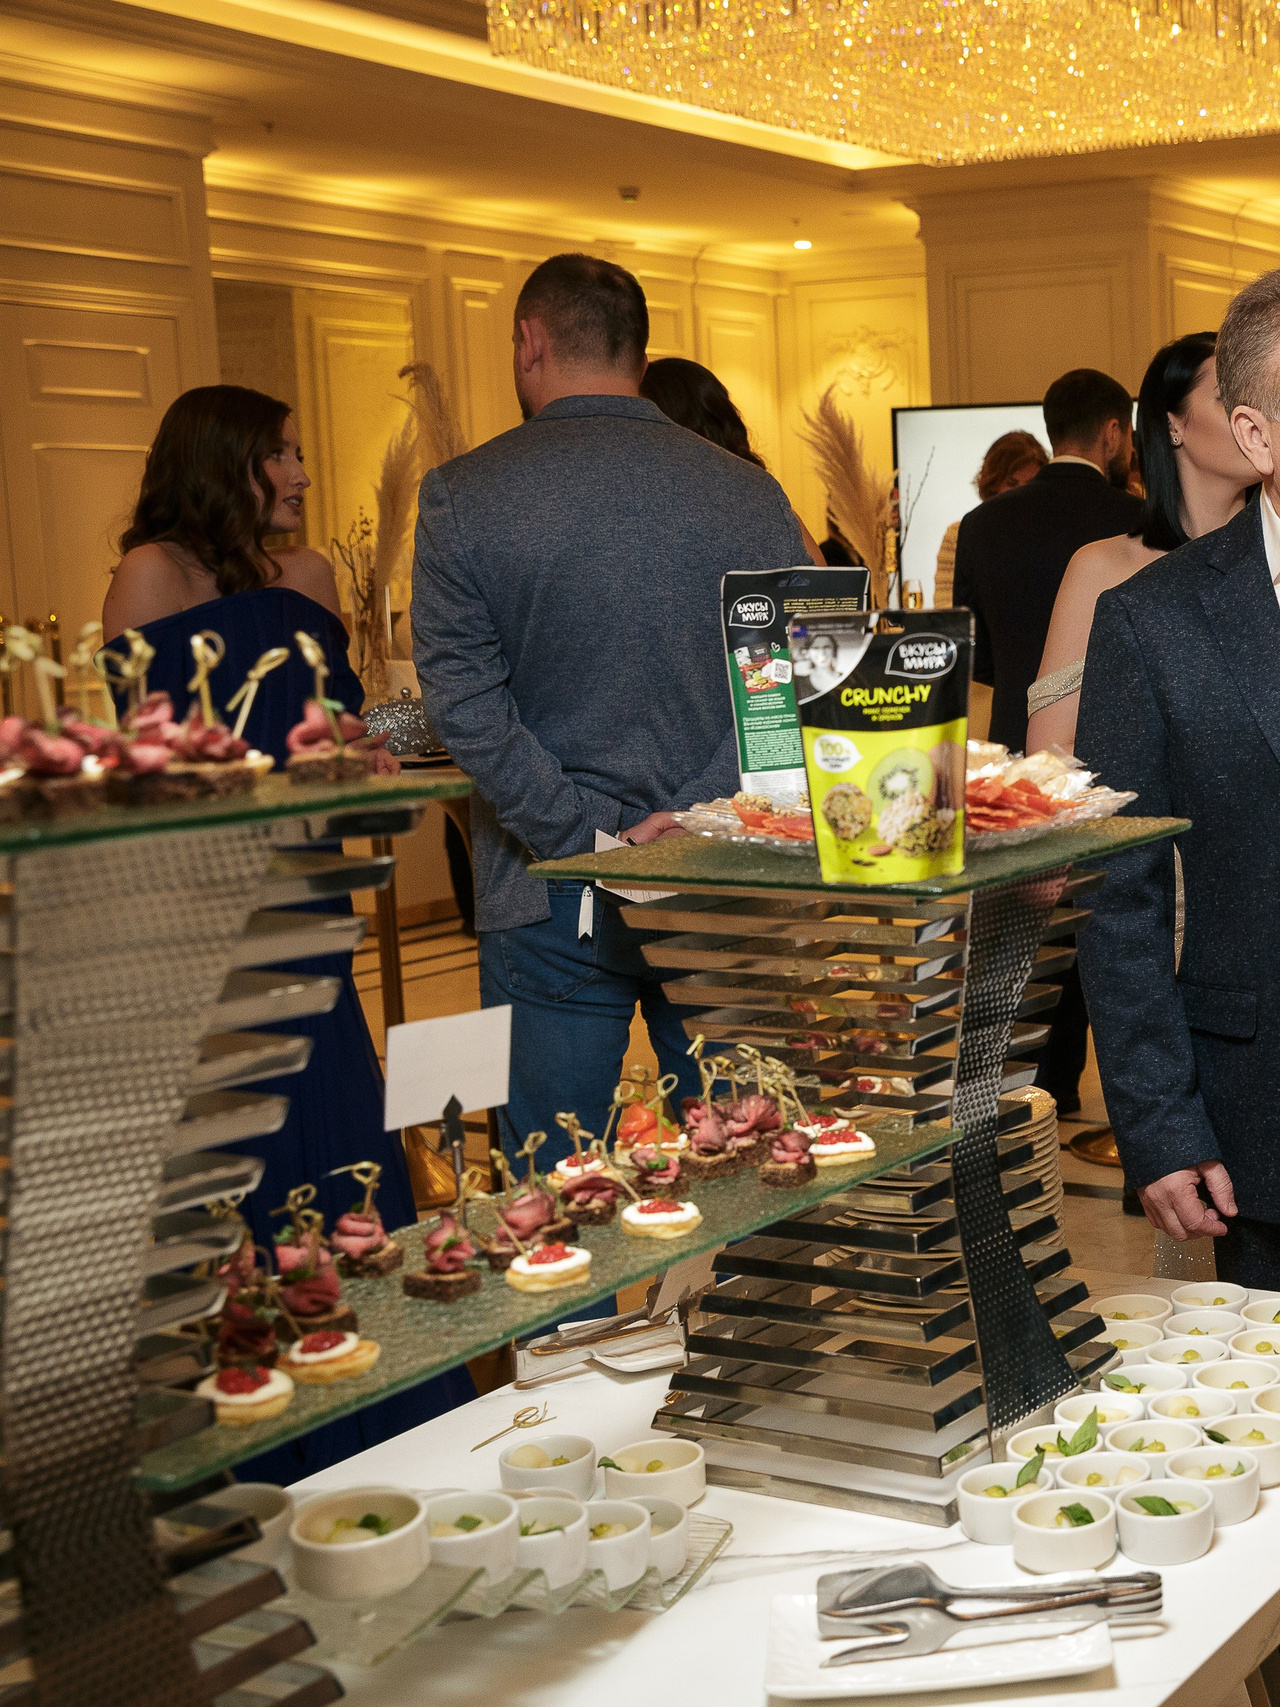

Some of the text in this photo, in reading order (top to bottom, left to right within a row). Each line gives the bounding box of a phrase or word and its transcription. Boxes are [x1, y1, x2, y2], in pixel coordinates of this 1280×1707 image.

[737, 601, 768, 614] ВКУСЫ
[742, 612, 768, 622] МИРА
[899, 642, 946, 658] ВКУСЫ
[903, 656, 945, 670] МИРА
[841, 684, 932, 707] CRUNCHY
